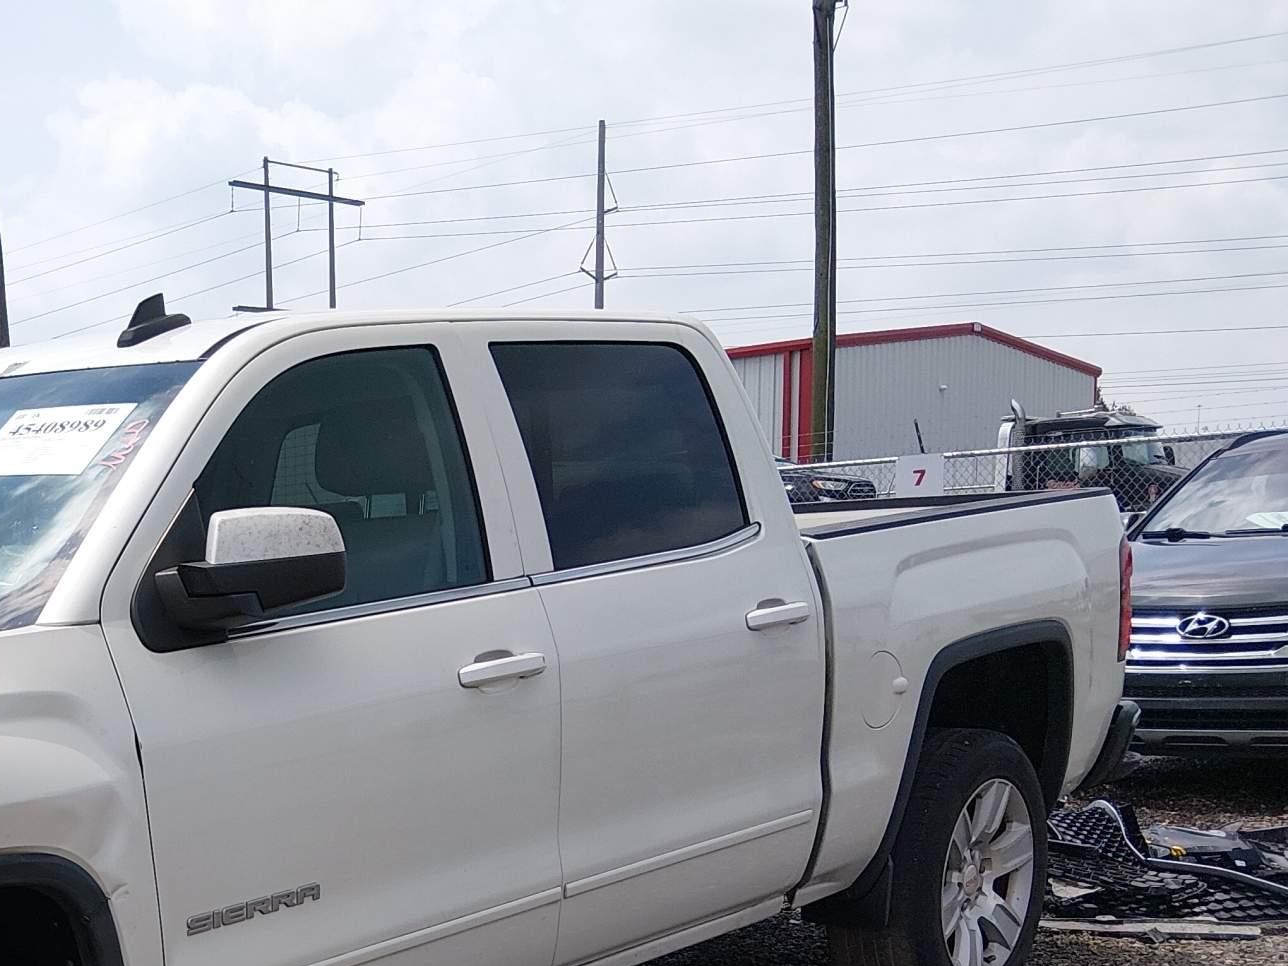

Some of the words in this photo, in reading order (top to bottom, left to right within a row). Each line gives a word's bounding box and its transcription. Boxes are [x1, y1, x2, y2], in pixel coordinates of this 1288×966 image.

[9, 418, 107, 437] 45408989
[912, 469, 926, 487] 7
[186, 881, 321, 937] SIERRA
